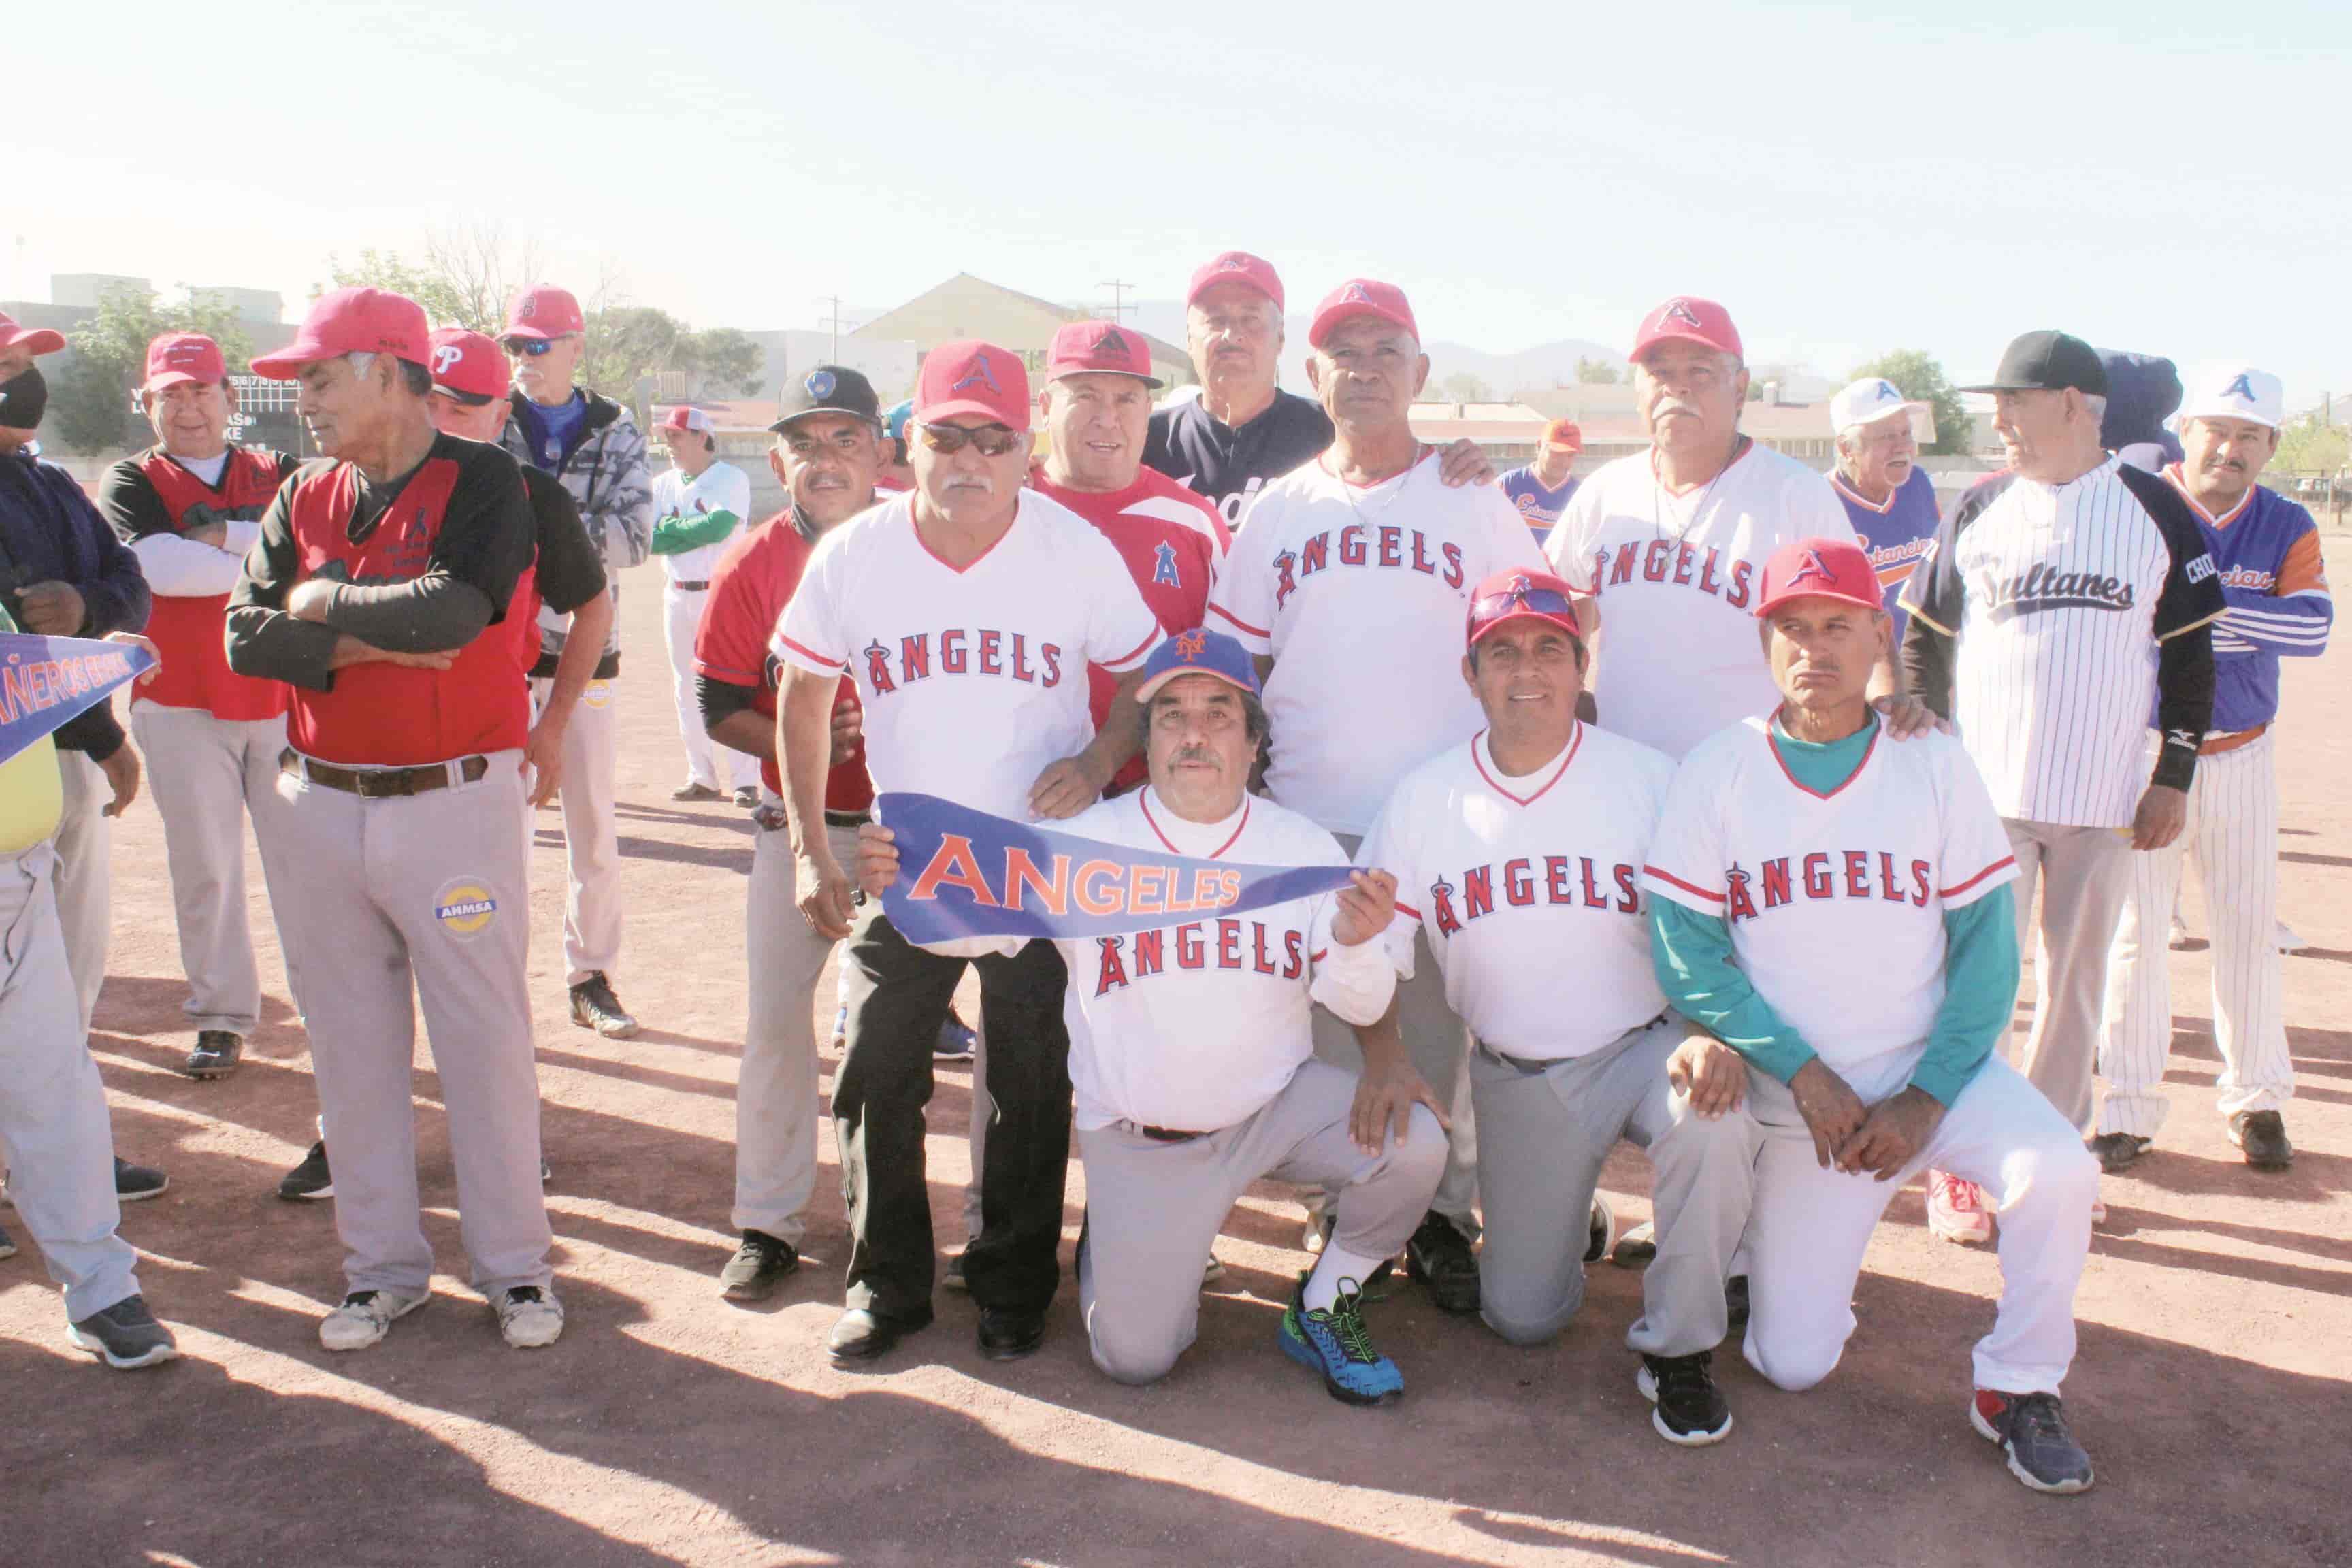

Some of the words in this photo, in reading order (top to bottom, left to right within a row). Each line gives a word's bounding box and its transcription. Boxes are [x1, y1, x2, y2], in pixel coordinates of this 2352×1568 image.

[1654, 299, 1701, 332] A
[251, 375, 259, 386] 7
[436, 345, 463, 374] P
[953, 353, 1002, 394] A
[1876, 380, 1900, 401] A
[2219, 373, 2258, 402] A
[1152, 538, 1181, 589] A
[1273, 525, 1465, 613] ANGELS
[1786, 549, 1839, 588] A
[1962, 553, 2135, 608] Sultanes
[863, 628, 1062, 696] ANGELS
[906, 832, 1243, 916] ANGELES
[1430, 855, 1639, 939] ANGELS
[1725, 850, 1931, 924] ANGELS
[441, 901, 493, 919] AHMSA
[1094, 918, 1303, 998] ANGELS
